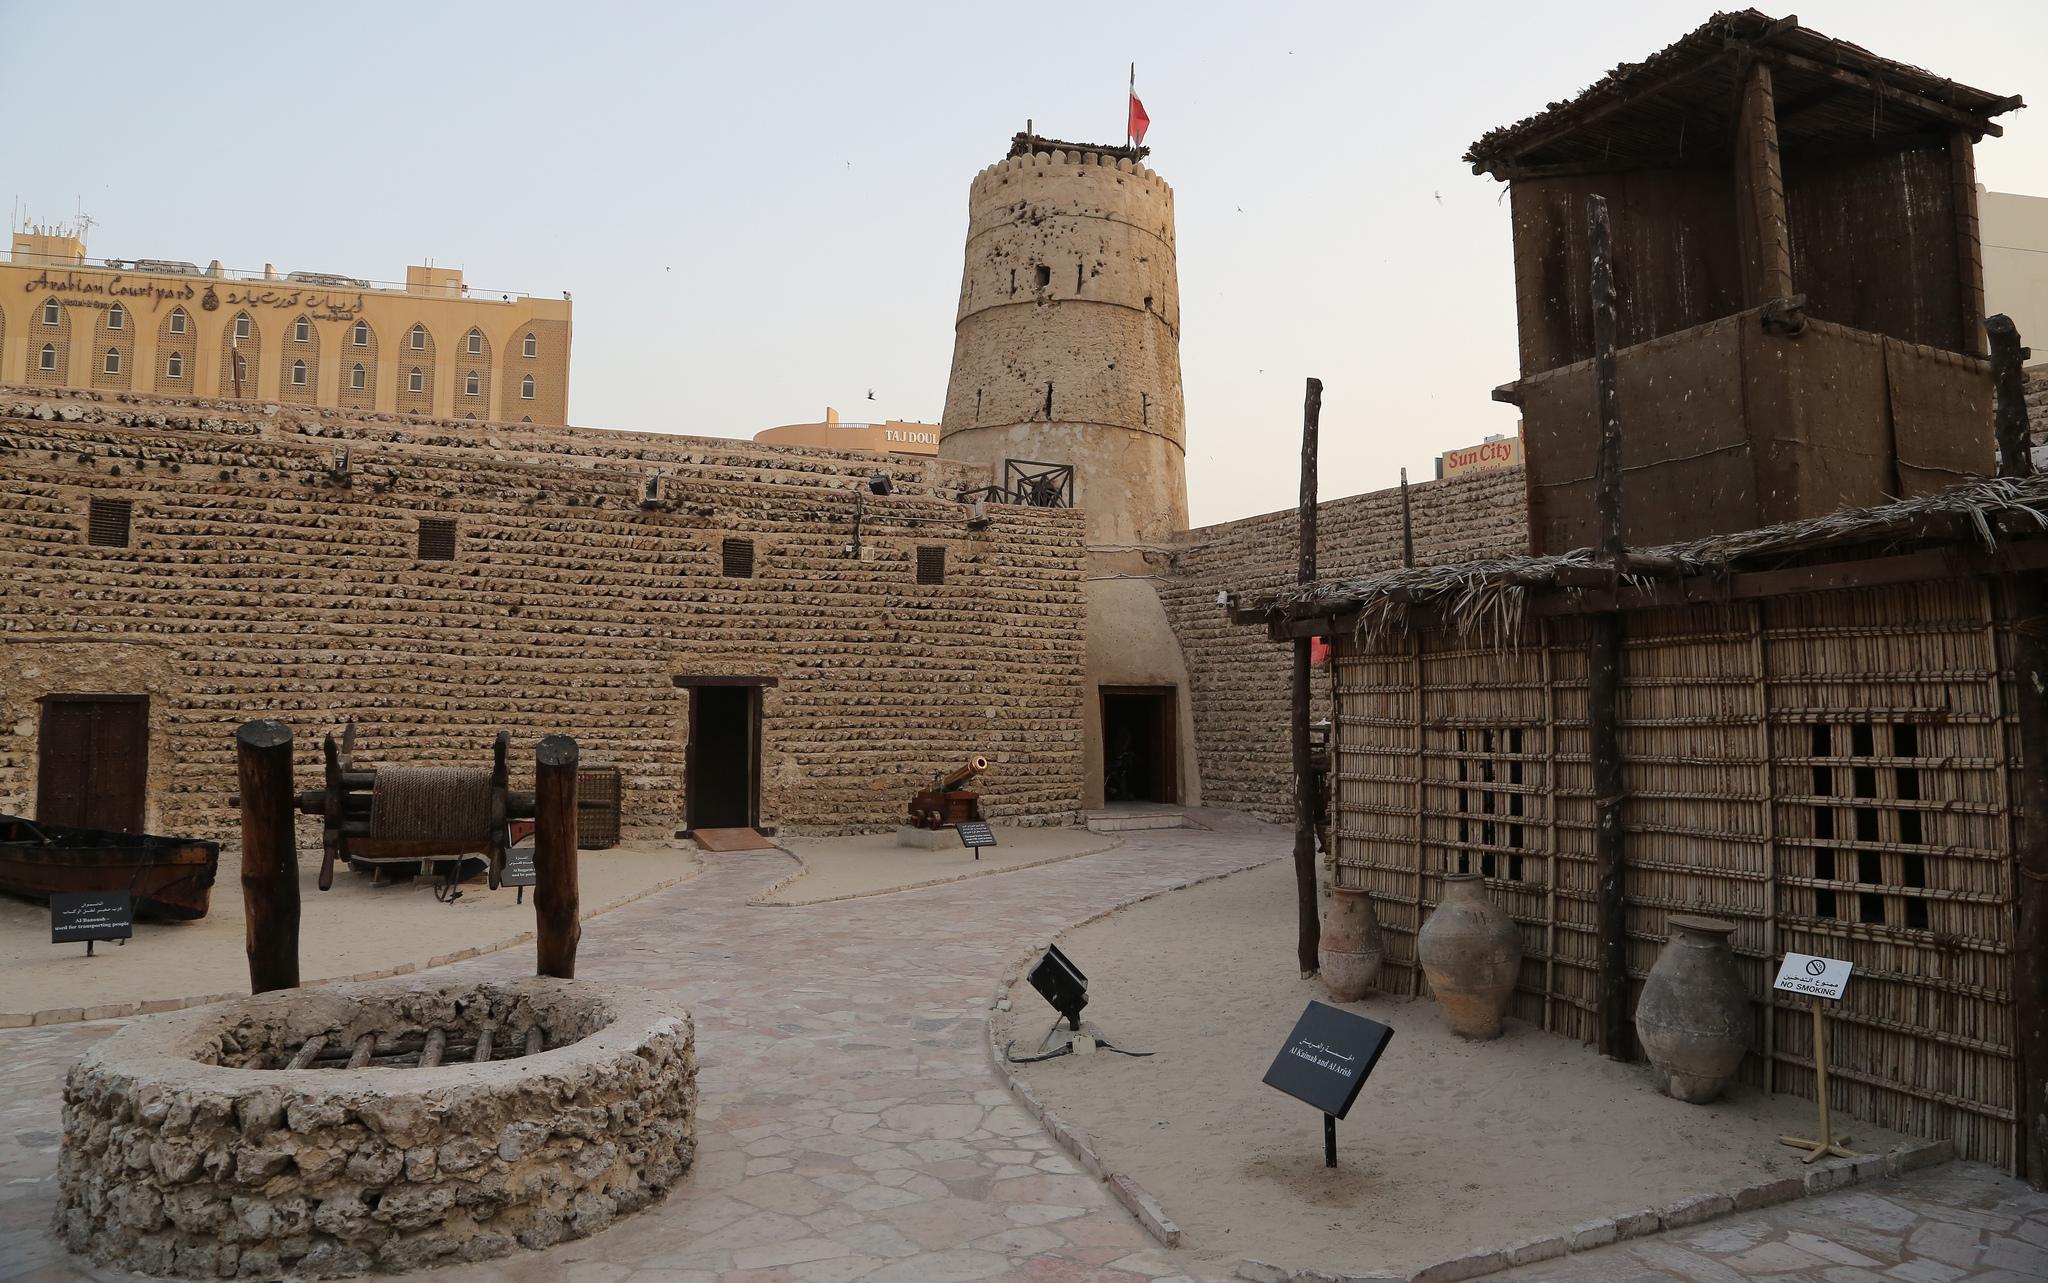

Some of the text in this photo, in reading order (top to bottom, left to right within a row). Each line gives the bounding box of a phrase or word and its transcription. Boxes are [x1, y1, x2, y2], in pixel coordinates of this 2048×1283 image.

[25, 270, 195, 313] Arabian Courtyard
[1449, 452, 1477, 468] Sun
[1480, 442, 1511, 461] City
[1780, 981, 1836, 996] NO SMOKING
[1783, 974, 1839, 988] ممنوع التدخين
[1288, 1046, 1298, 1055] Al
[1316, 1059, 1330, 1068] and
[1327, 1062, 1337, 1071] Al
[1334, 1065, 1352, 1077] Arish
